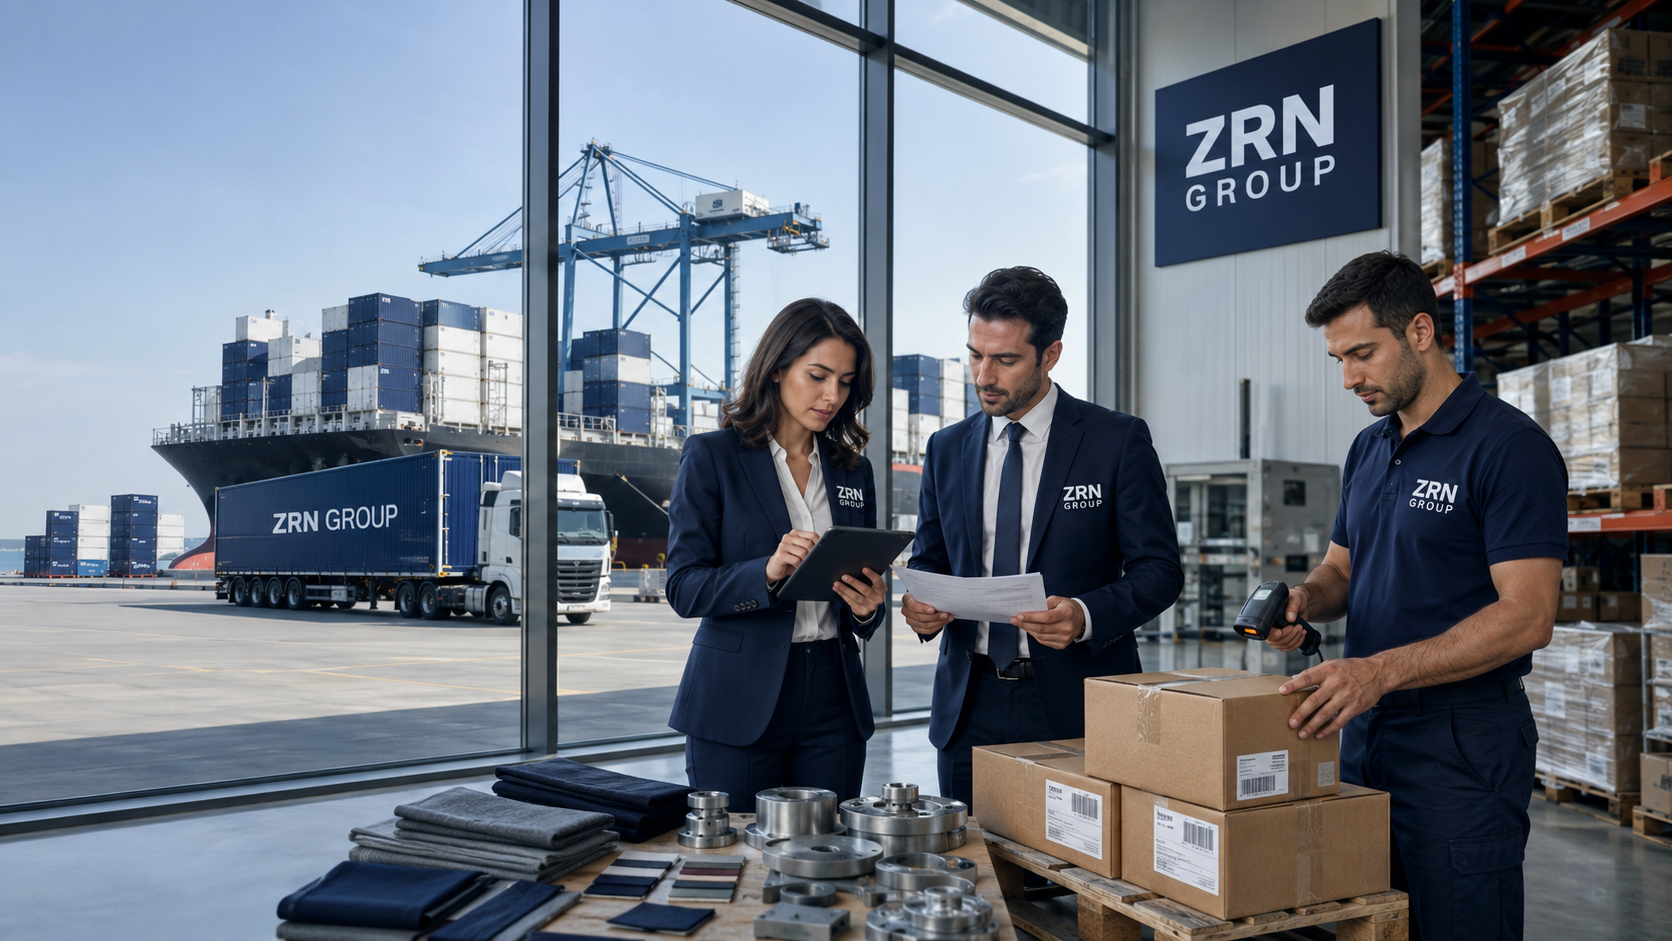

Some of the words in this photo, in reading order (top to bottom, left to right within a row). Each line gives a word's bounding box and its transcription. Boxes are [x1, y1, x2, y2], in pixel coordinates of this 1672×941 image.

[1185, 84, 1335, 179] ZRN
[1185, 154, 1336, 212] GROUP
[836, 485, 864, 501] ZRN
[1063, 483, 1102, 502] ZRN
[1411, 478, 1459, 504] ZRN
[1063, 499, 1103, 510] GROUP
[1408, 498, 1454, 514] GROUP
[272, 510, 319, 534] ZRN
[325, 504, 398, 531] GROUP
